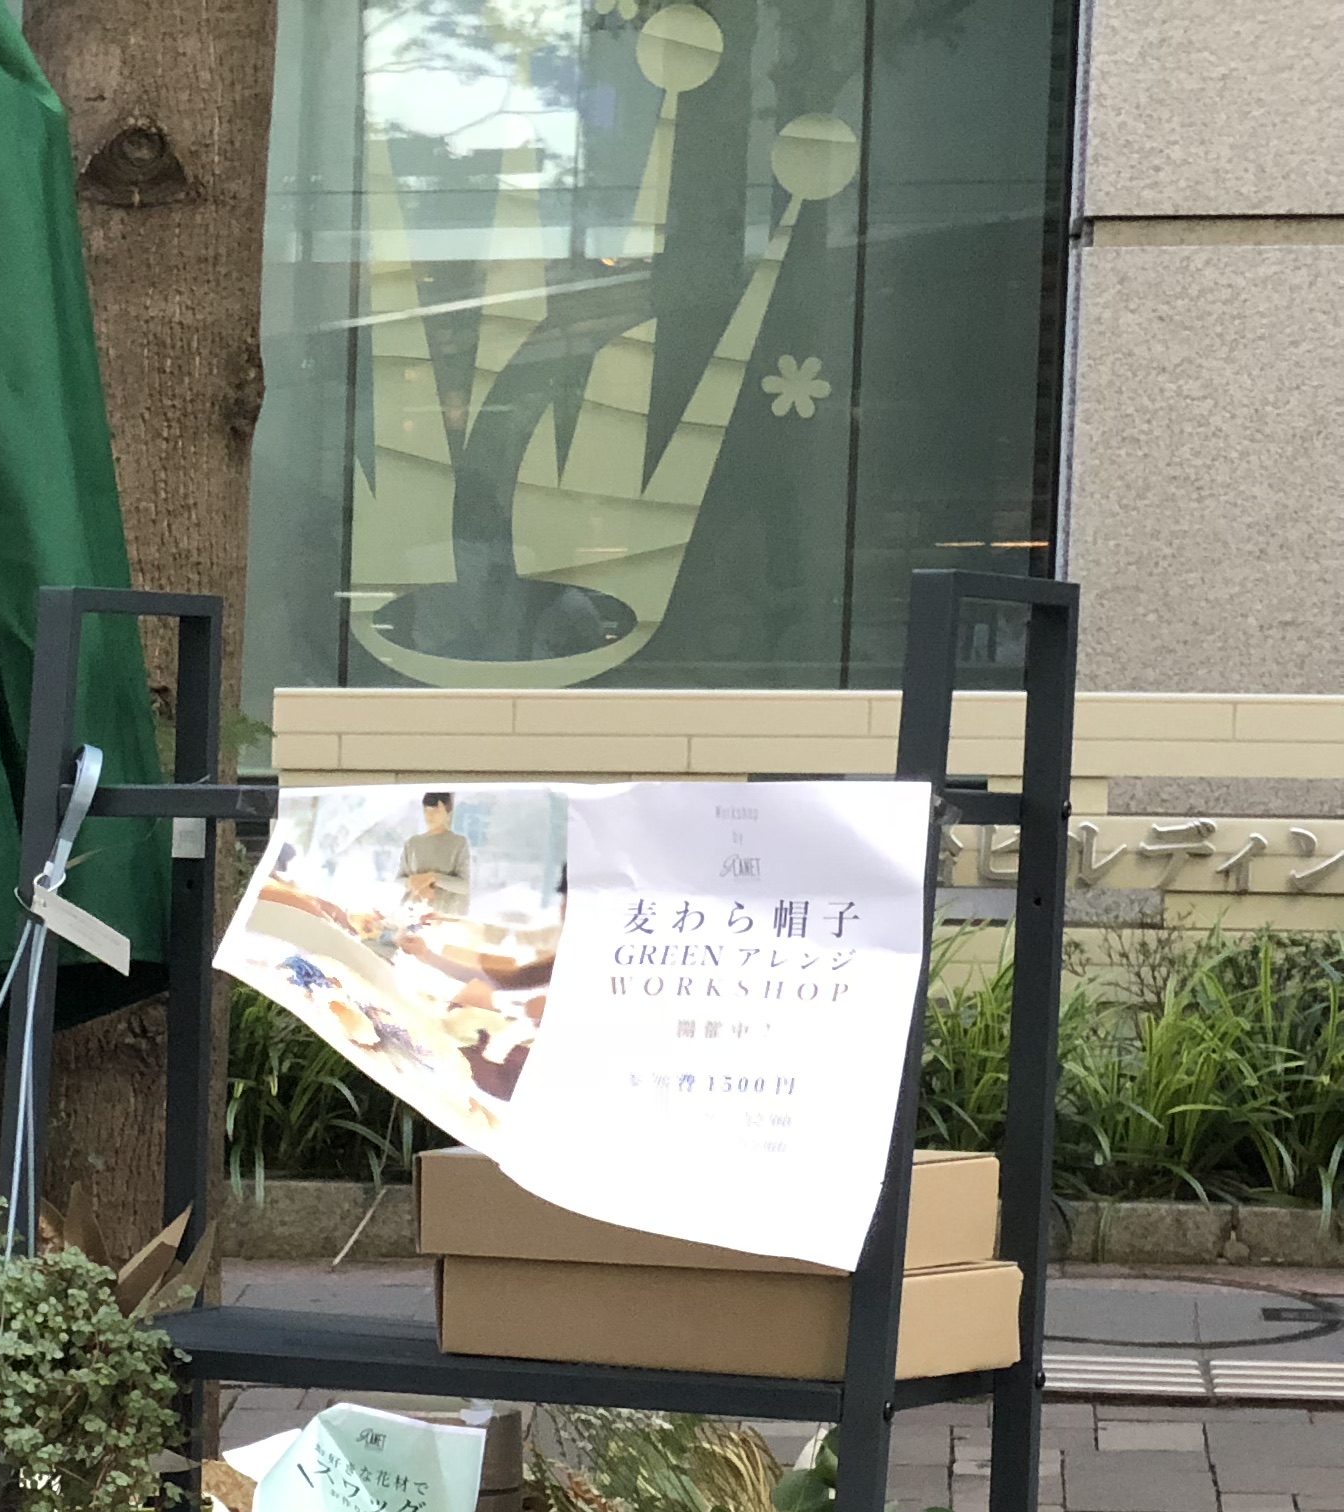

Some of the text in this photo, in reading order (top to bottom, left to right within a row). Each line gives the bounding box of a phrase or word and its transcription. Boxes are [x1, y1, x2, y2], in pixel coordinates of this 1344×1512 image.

[715, 804, 760, 822] Workshop
[732, 831, 744, 847] by
[623, 898, 861, 939] 麦わら帽子
[614, 944, 857, 971] GREEN アレンジ
[610, 975, 849, 1002] WORKSHOP
